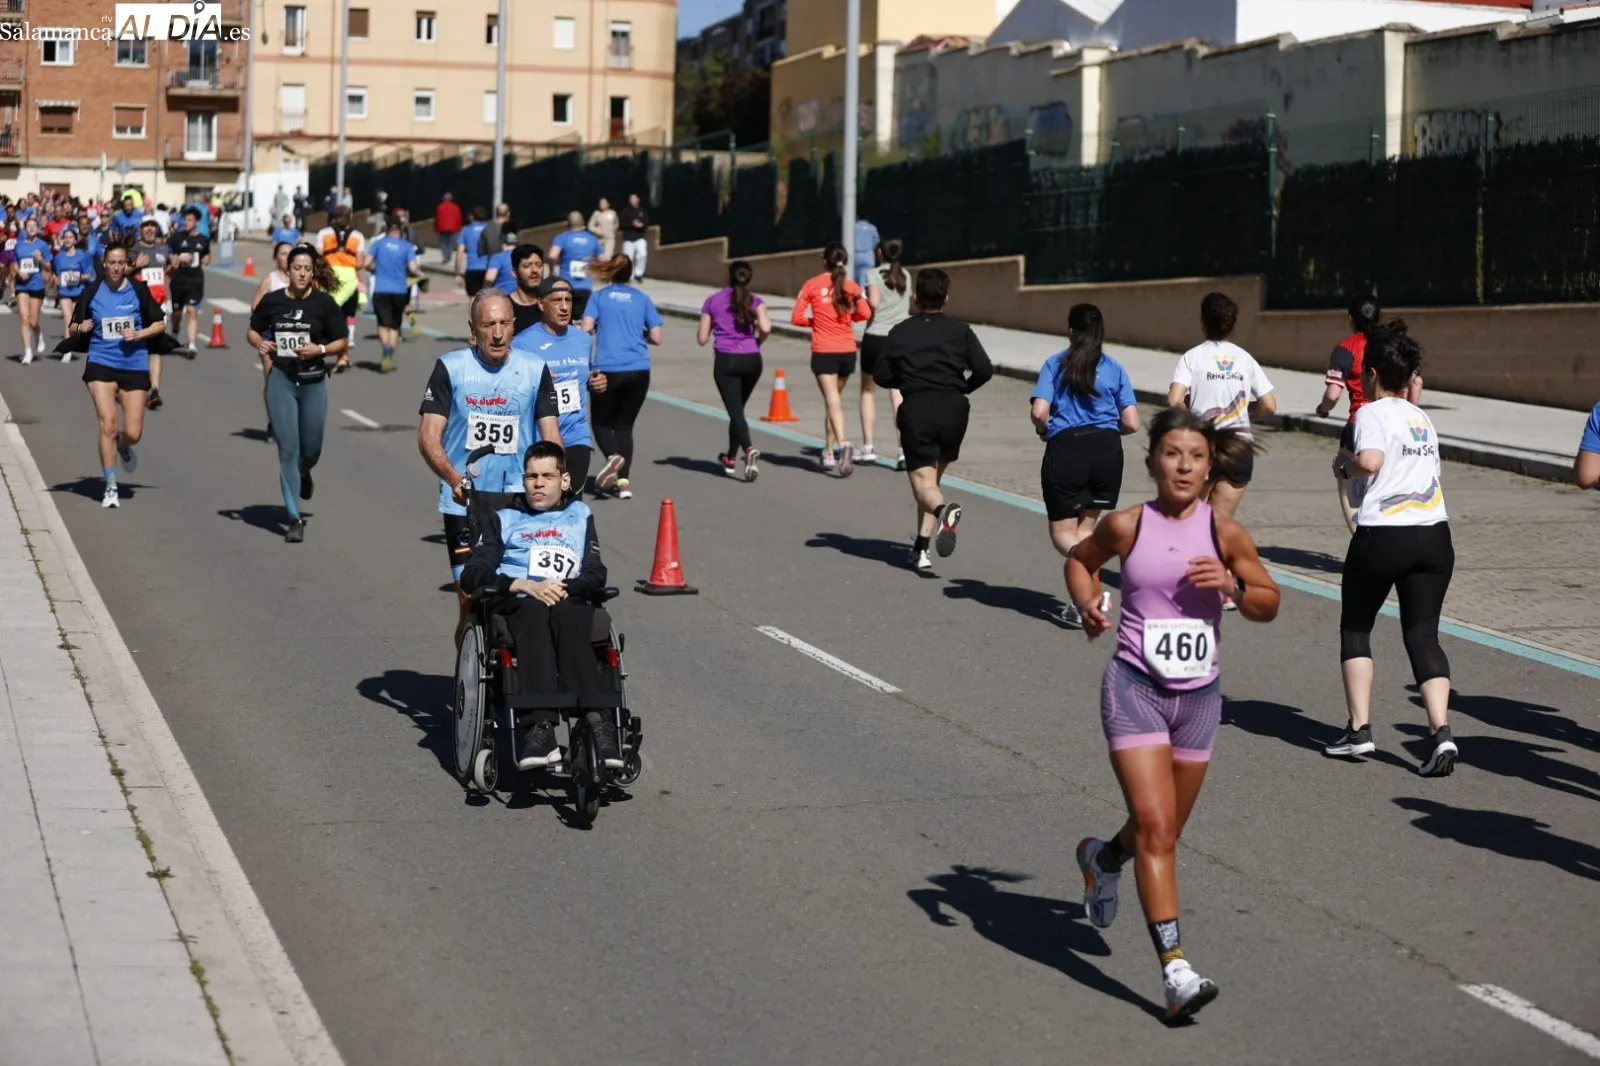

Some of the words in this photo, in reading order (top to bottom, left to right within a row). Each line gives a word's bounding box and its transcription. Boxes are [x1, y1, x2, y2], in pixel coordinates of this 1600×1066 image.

[106, 320, 130, 333] 168
[1206, 372, 1225, 381] Reina
[561, 388, 571, 404] 5
[474, 421, 514, 444] 359
[538, 550, 575, 578] 357
[1155, 632, 1208, 661] 460
